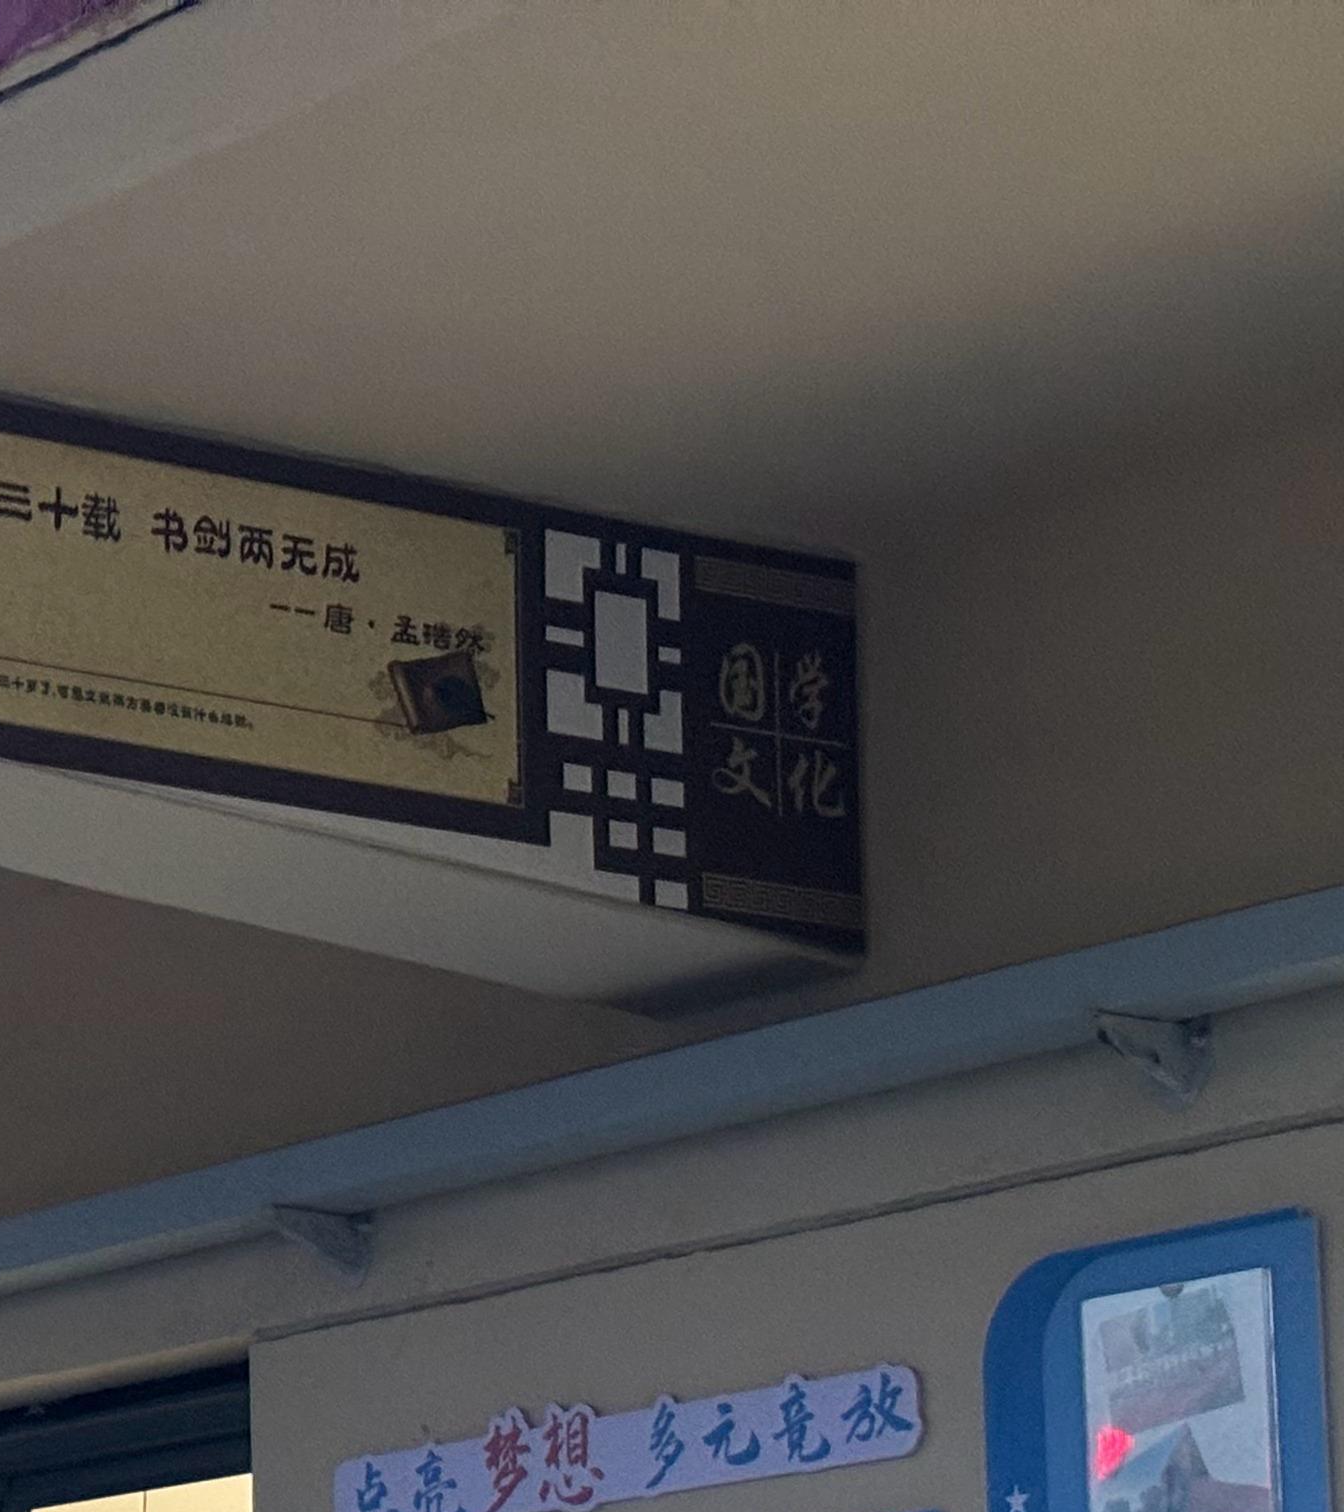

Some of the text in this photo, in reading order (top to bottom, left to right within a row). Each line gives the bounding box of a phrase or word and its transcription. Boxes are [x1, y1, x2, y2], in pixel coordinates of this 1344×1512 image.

[151, 507, 361, 584] 书剑两无成
[713, 735, 847, 818] 文化
